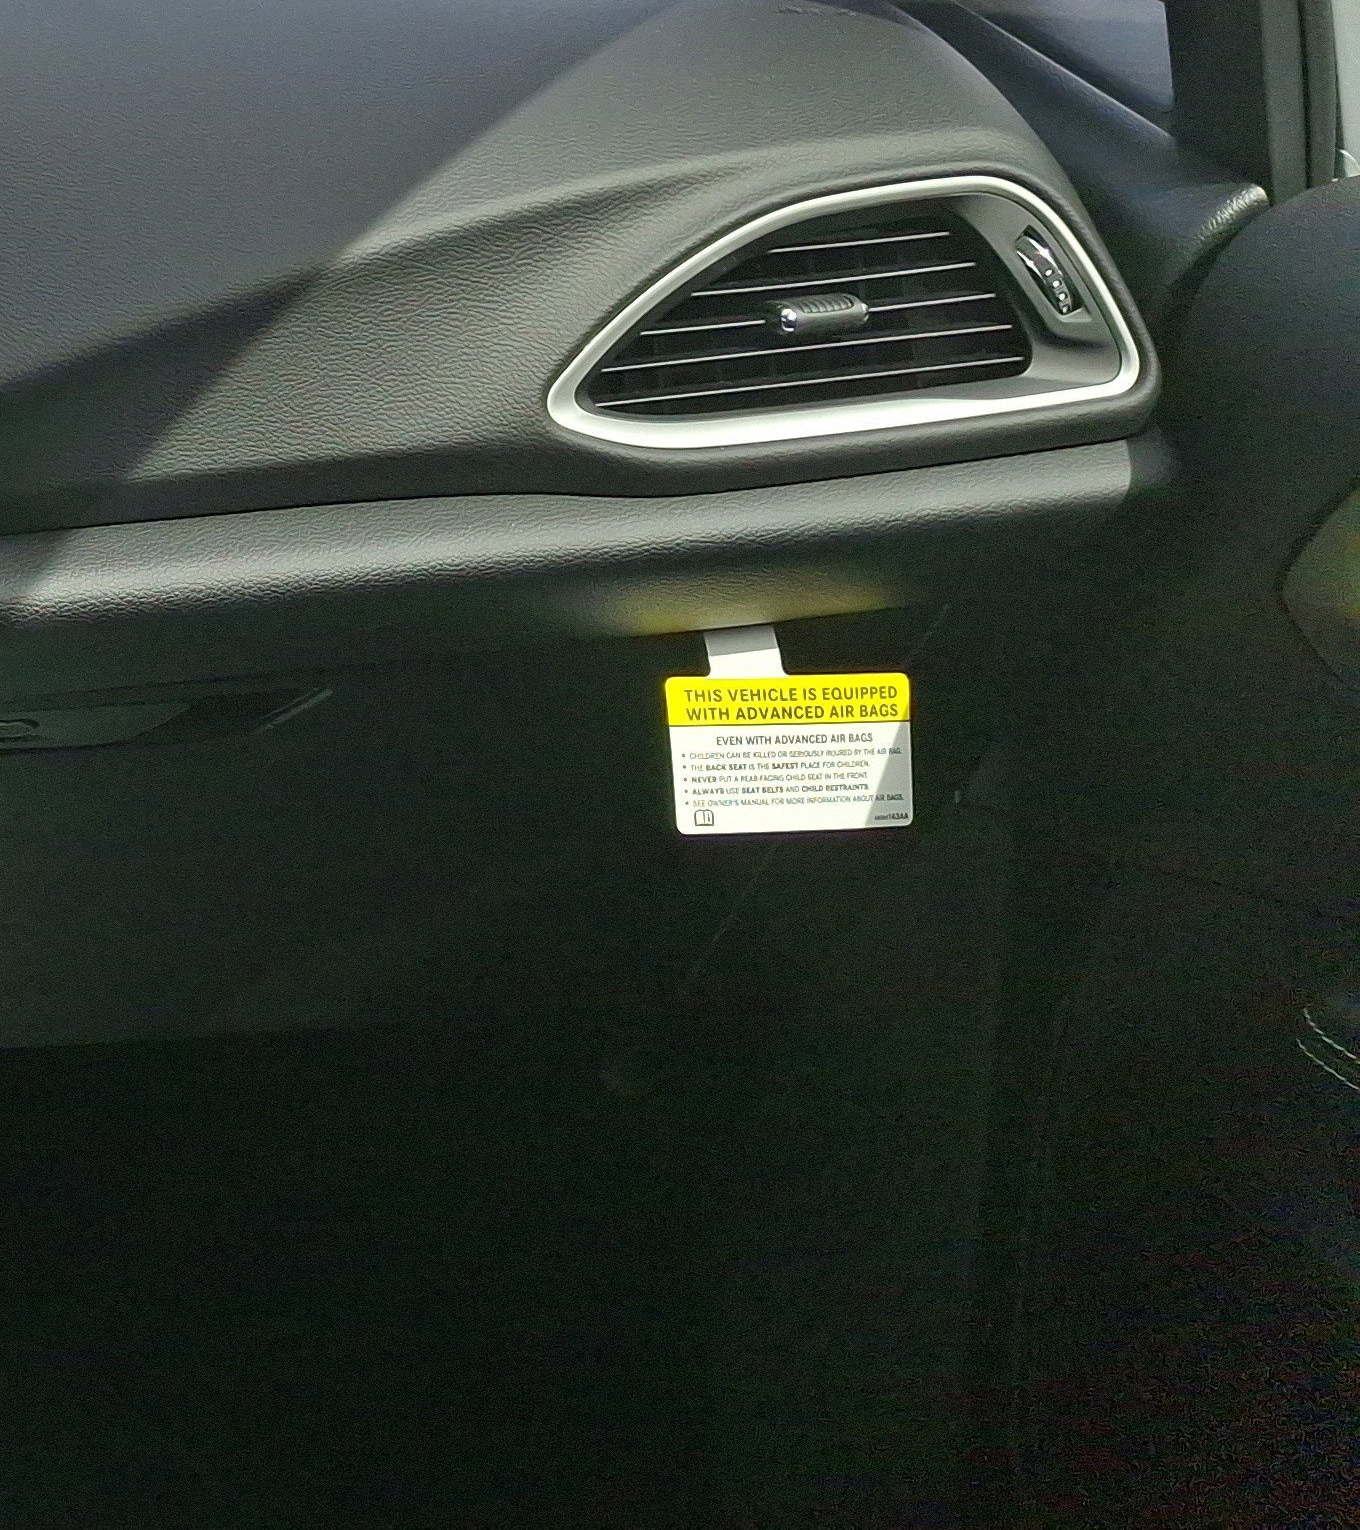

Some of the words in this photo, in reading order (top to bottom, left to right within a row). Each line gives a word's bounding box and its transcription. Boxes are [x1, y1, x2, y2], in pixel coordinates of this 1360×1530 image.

[684, 688, 723, 703] THIS
[727, 687, 798, 702] VEHICLE
[802, 687, 817, 701] IS
[821, 685, 898, 700] EQUIPPED
[685, 706, 730, 721] WITH
[735, 705, 825, 720] ADVANCED
[829, 704, 855, 718] AIR
[859, 703, 899, 718] BAGS
[716, 735, 743, 746] EVEN
[745, 735, 772, 745] WITH
[774, 733, 828, 745] ADVANCED
[830, 733, 846, 744] AIR
[848, 732, 874, 743] BAGS
[689, 752, 725, 760] CHILDREN
[726, 751, 741, 759] CAN
[742, 751, 751, 759] BE
[777, 750, 788, 758] OR
[863, 748, 875, 756] THE
[690, 764, 704, 772] THE
[728, 763, 747, 771] SEAT
[757, 762, 770, 770] THE
[772, 762, 799, 770] SAFEST
[800, 761, 821, 769] PLACE
[822, 761, 835, 769] FOR
[691, 776, 717, 784] NEVER
[832, 772, 845, 780] THE
[692, 787, 725, 796] ALWAYS
[741, 786, 760, 794] SEAT
[762, 786, 784, 794] BELTS
[801, 784, 824, 792] CHILD
[741, 798, 769, 806] MANUAL
[771, 797, 785, 805] FOR
[786, 797, 805, 805] MORE
[852, 794, 874, 803] ABOUT
